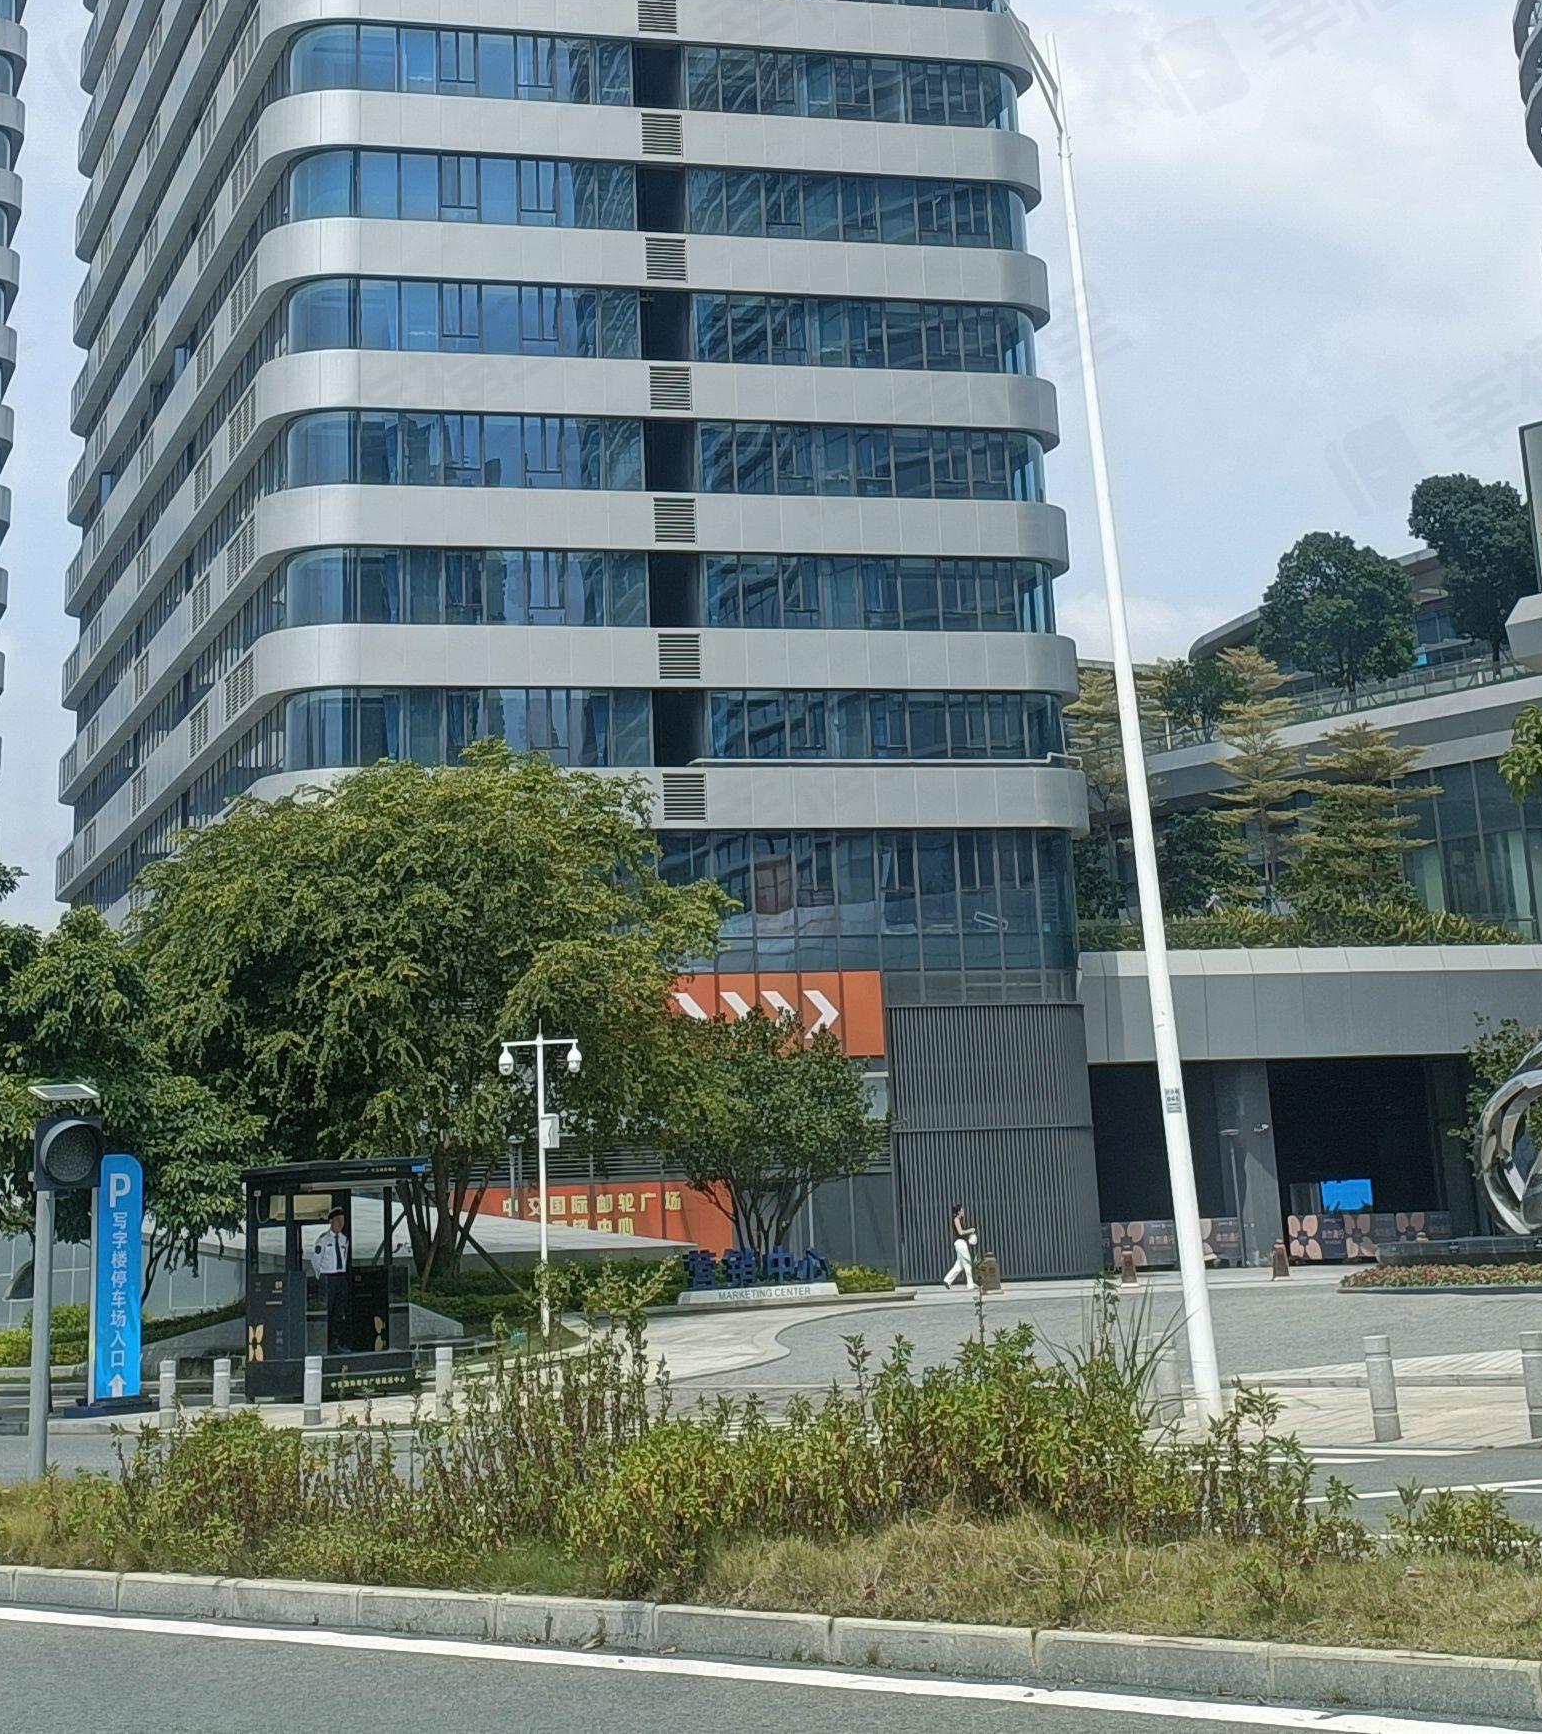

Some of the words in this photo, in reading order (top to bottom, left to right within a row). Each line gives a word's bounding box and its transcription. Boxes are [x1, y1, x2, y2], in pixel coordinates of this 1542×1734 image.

[109, 1173, 131, 1208] P
[682, 1245, 831, 1290] 营销中心
[110, 1212, 128, 1367] 写字楼停车场入口
[718, 1288, 776, 1300] MARKETING
[774, 1286, 811, 1296] CENTER
